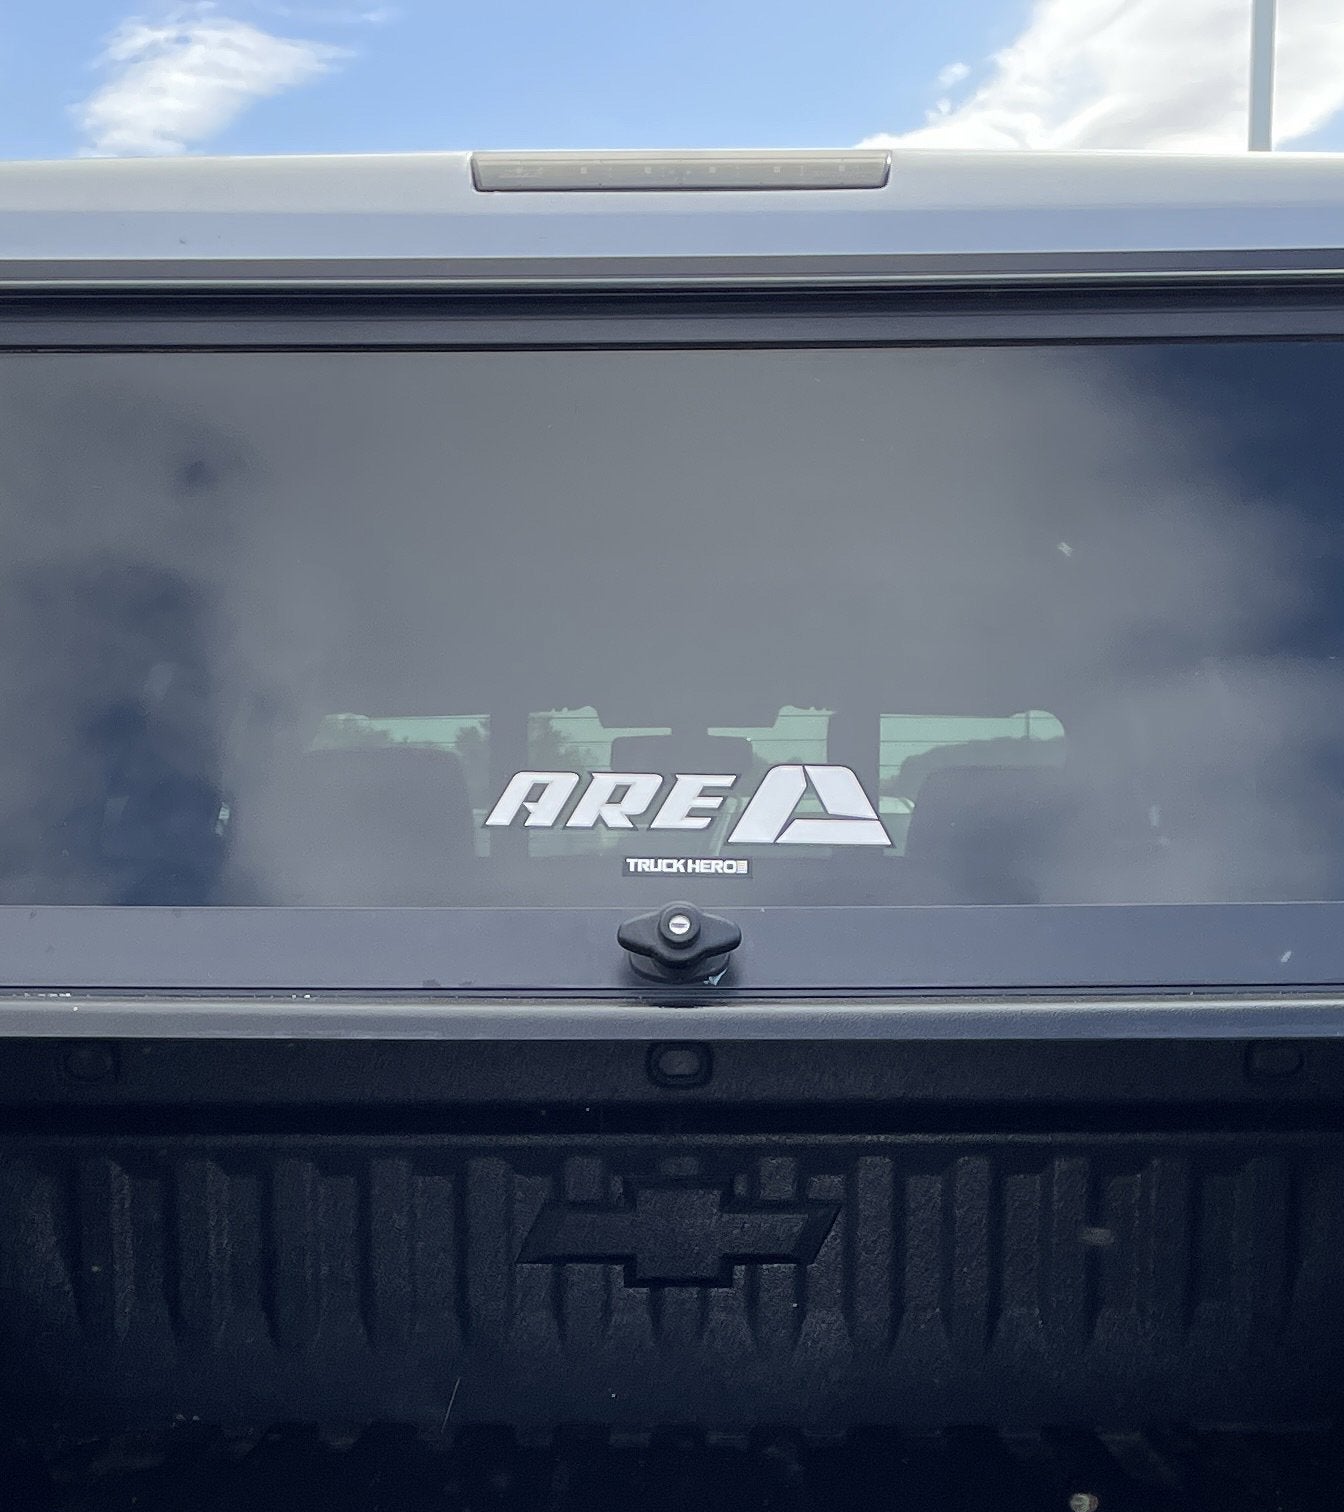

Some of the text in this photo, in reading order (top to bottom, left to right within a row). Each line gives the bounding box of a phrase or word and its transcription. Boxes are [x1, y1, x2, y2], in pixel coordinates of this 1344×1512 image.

[485, 771, 737, 829] ARE
[626, 858, 736, 874] TRUCK HERO
